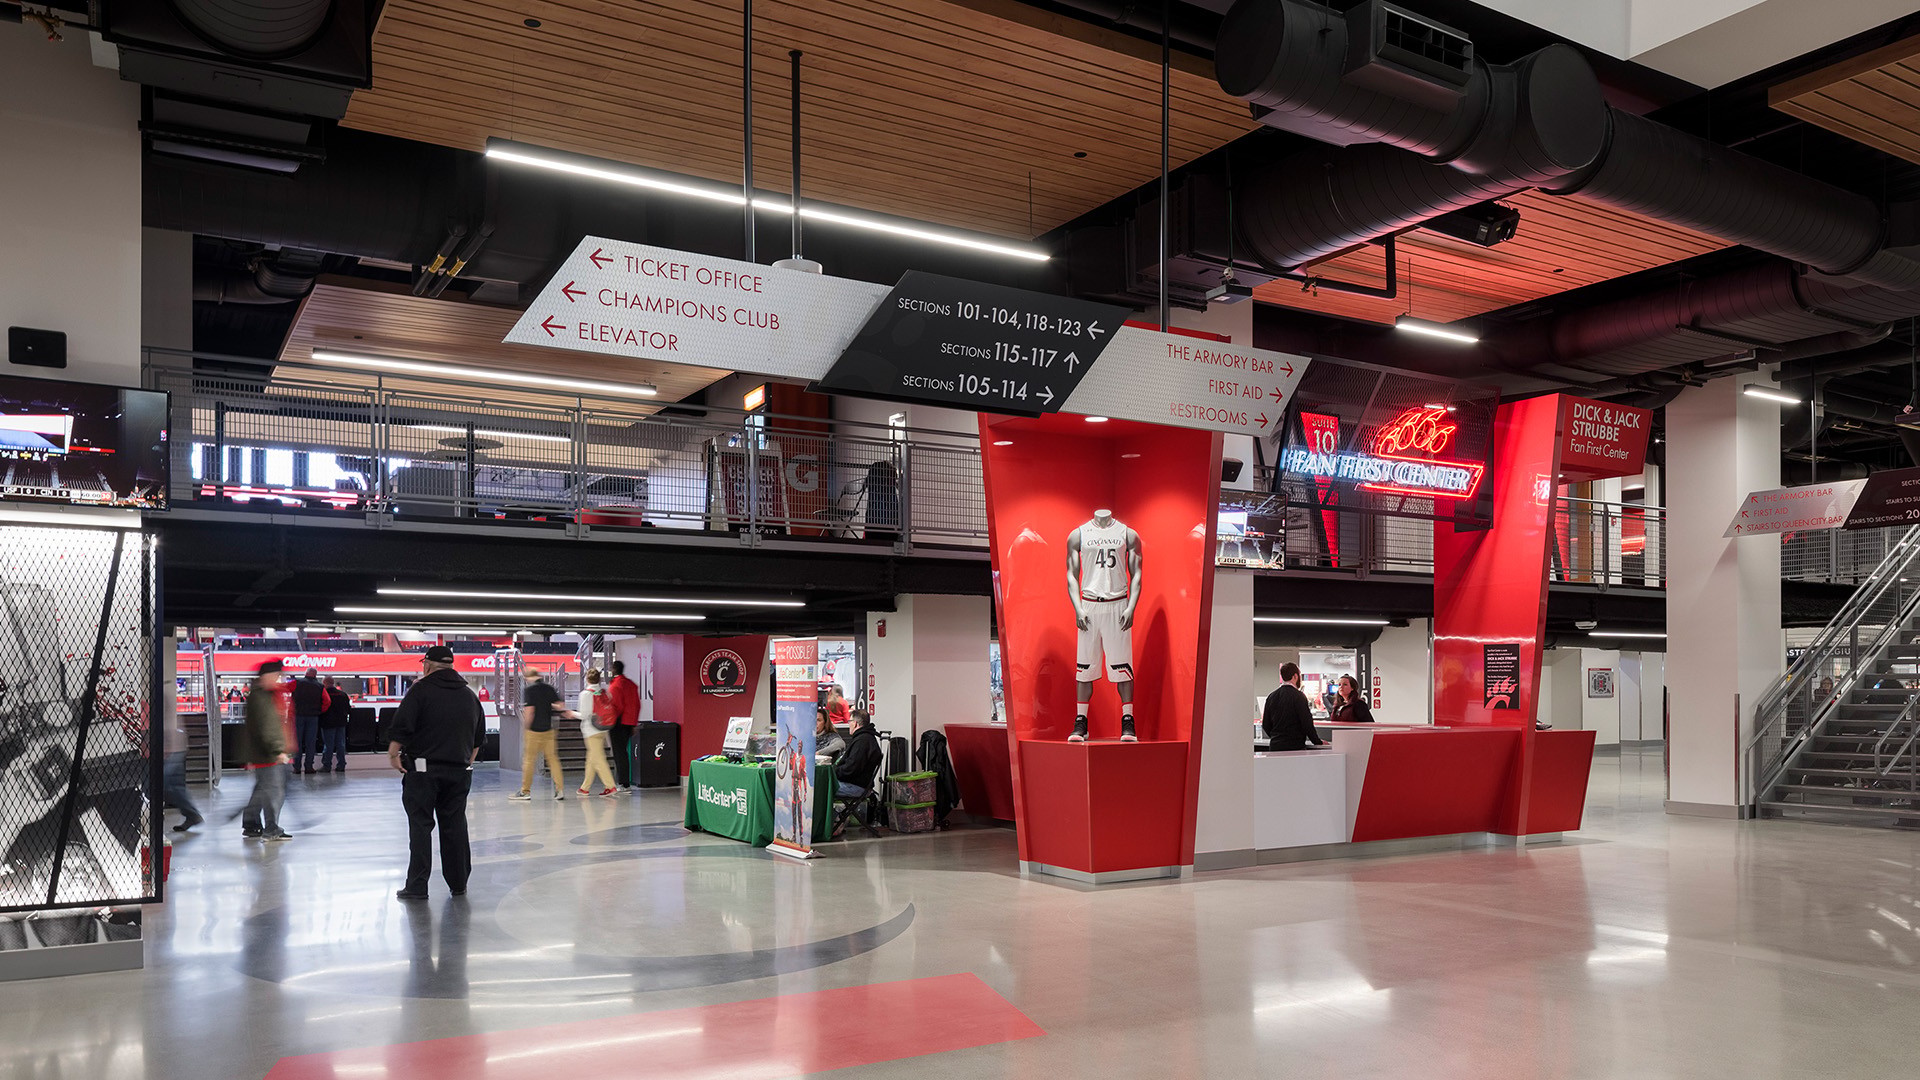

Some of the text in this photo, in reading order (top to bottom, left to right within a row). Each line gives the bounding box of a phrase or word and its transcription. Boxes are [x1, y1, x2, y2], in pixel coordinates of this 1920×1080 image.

[624, 255, 763, 293] TICKET OFFICE
[598, 288, 781, 330] CHAMPIONS CLUB
[898, 297, 951, 316] SECTIONS
[578, 322, 678, 351] ELEVATOR
[941, 341, 1058, 368] SECTIONS 115-117
[1166, 343, 1275, 375] THE ARMORY BAR
[902, 373, 1028, 401] SECTIONS 105-114
[1209, 379, 1264, 400] FIRST AID
[1169, 402, 1248, 426] RESTROOMS
[1312, 418, 1335, 429] SUITE
[1573, 403, 1641, 429] DICK & JACK
[1314, 429, 1335, 454] 10
[1571, 420, 1620, 442] STRUBBE
[1570, 439, 1630, 460] Fan First Center
[1291, 450, 1470, 490] FAN FIRST CENTER
[1763, 488, 1833, 503] THE ARMORY BAR
[1746, 515, 1843, 532] STAIRS TO QUEEN CITY BAR
[1753, 507, 1789, 518] FIRST AID
[1875, 514, 1904, 523] SECTIONS
[1095, 549, 1116, 568] 45
[282, 654, 337, 668] CINCINNATI
[703, 651, 744, 676] BEARCATS TEAM SHOP
[698, 782, 731, 808] LifeCenter
